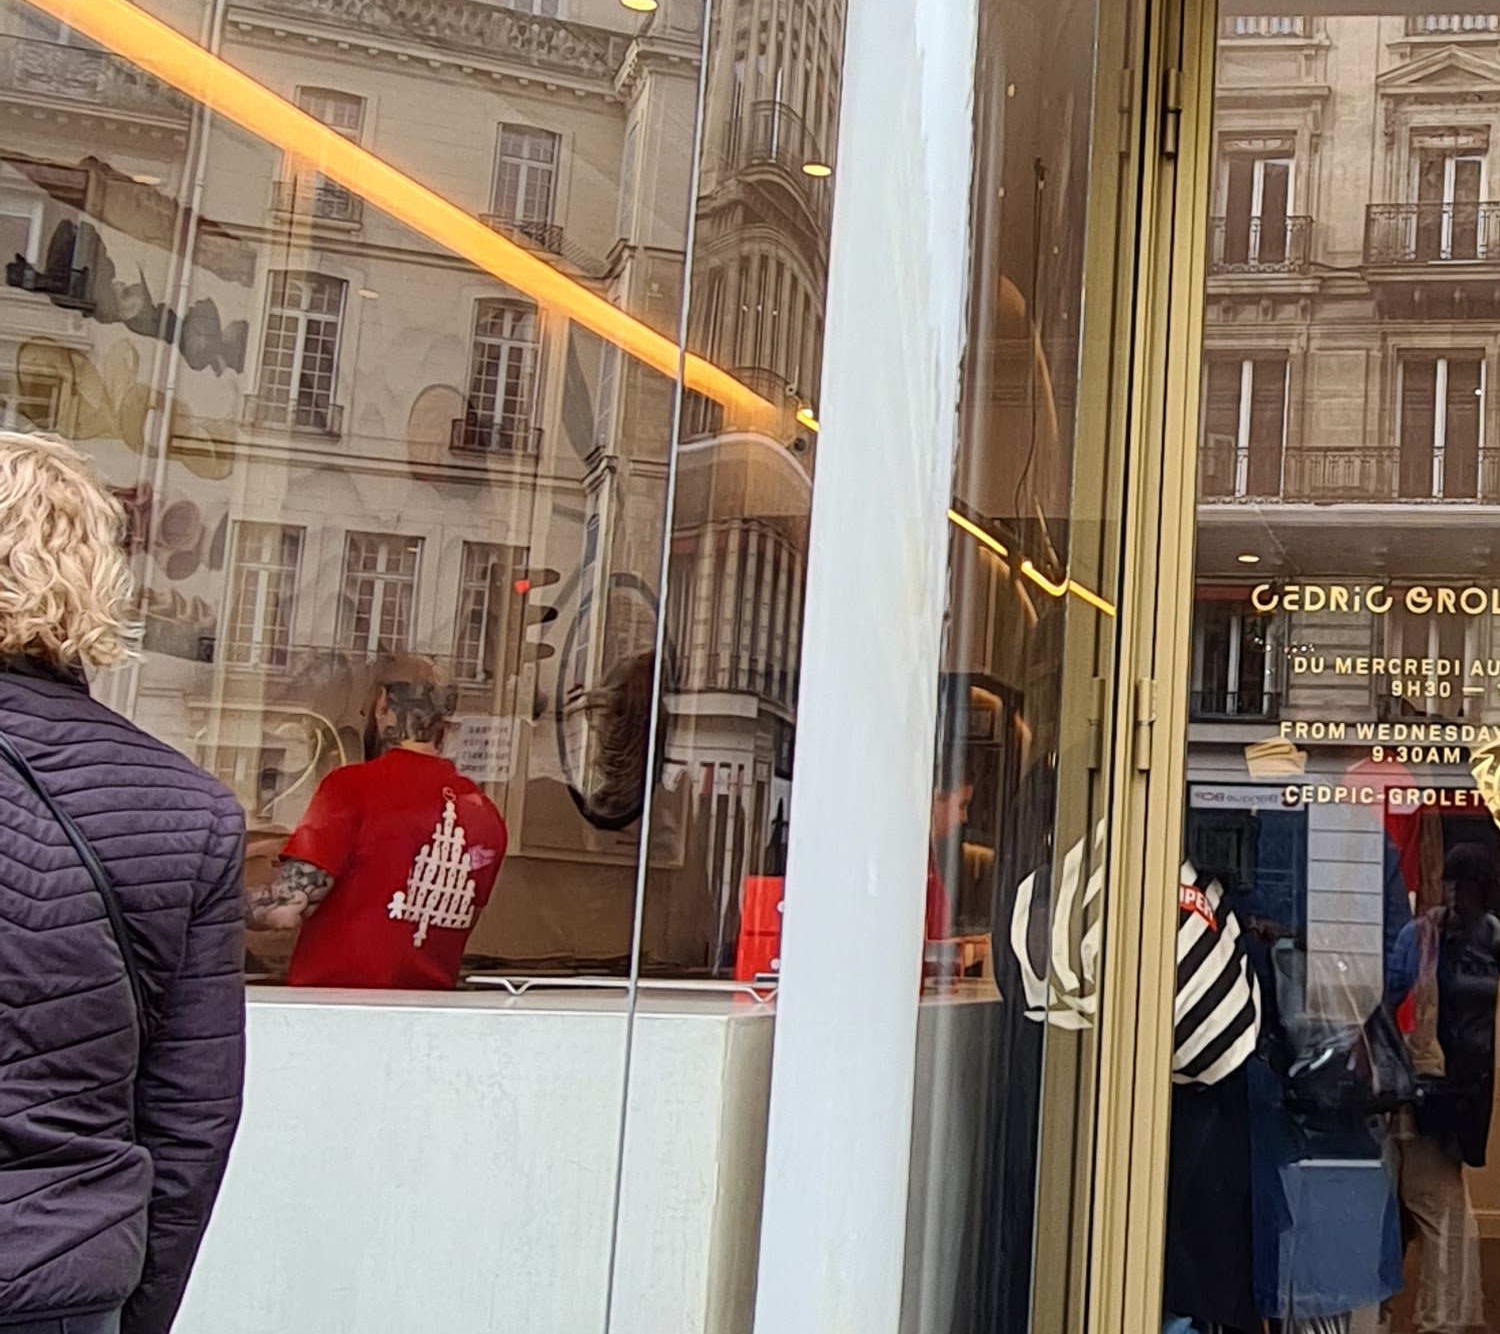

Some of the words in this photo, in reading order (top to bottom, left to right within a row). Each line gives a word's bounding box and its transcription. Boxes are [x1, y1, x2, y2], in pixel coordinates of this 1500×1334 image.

[1294, 657, 1324, 674] DU
[1335, 658, 1460, 676] MERCREDI
[1470, 660, 1500, 677] AU
[1392, 681, 1451, 698] 9H30
[1281, 722, 1345, 740] FROM
[1372, 746, 1460, 764] 9.30AM
